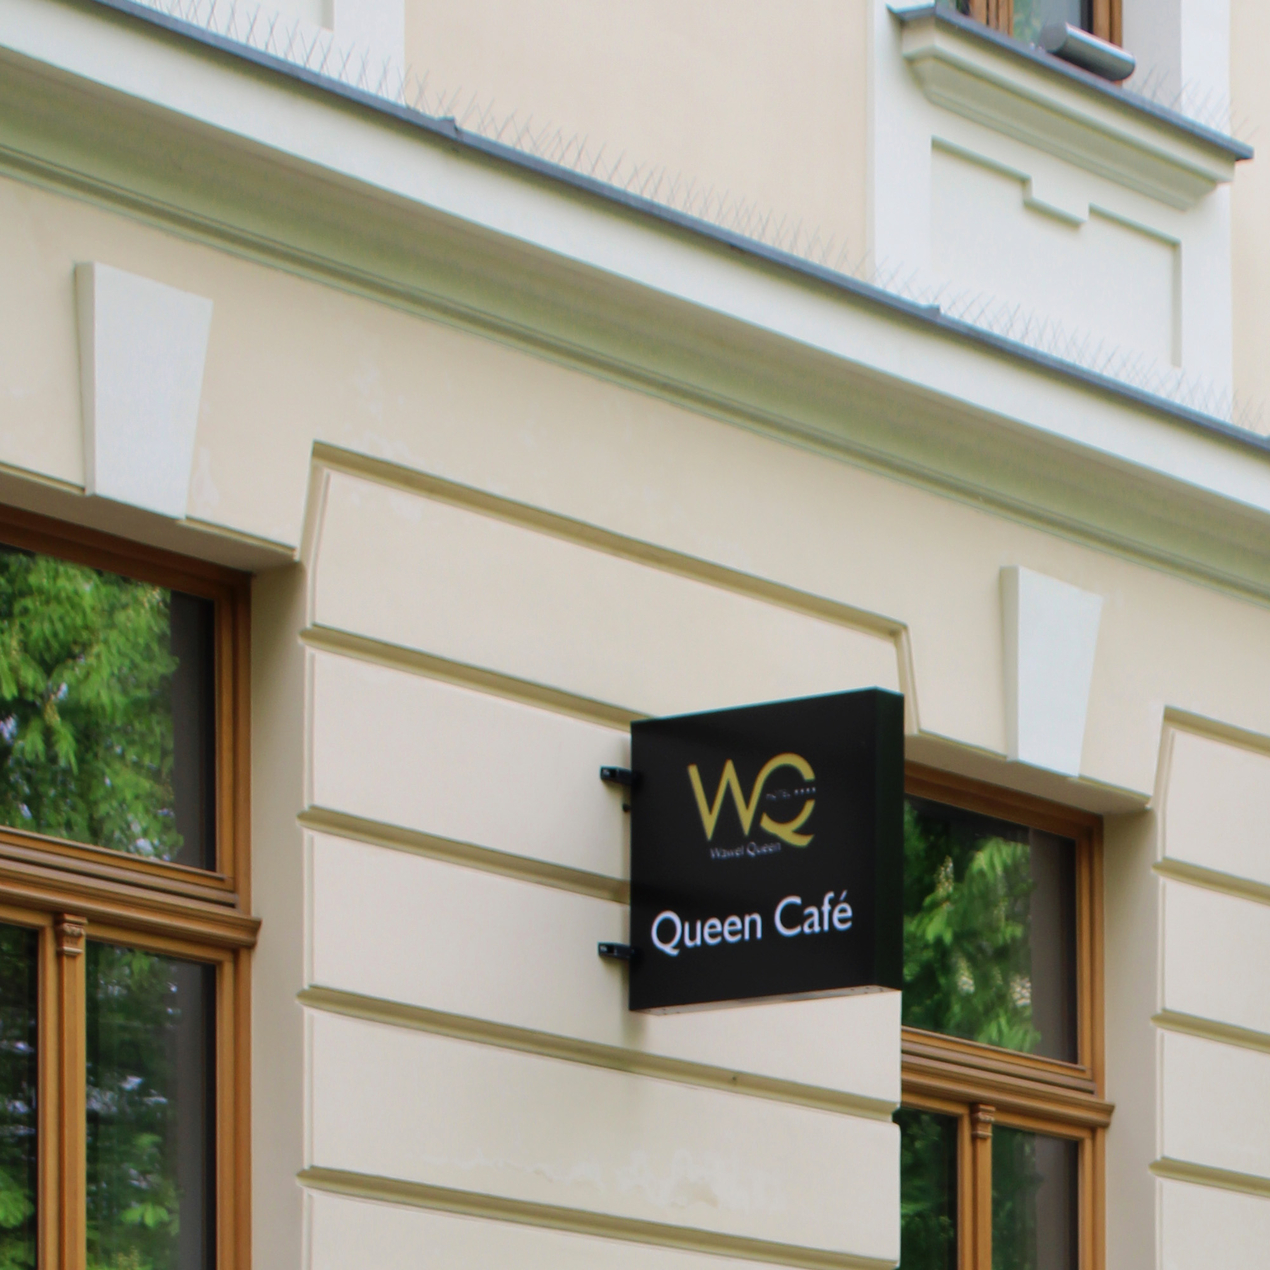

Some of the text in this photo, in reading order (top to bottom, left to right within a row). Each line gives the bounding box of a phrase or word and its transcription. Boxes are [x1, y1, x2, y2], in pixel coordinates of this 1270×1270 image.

[710, 842, 781, 859] Wawel Queen
[651, 890, 853, 956] Queen Café
